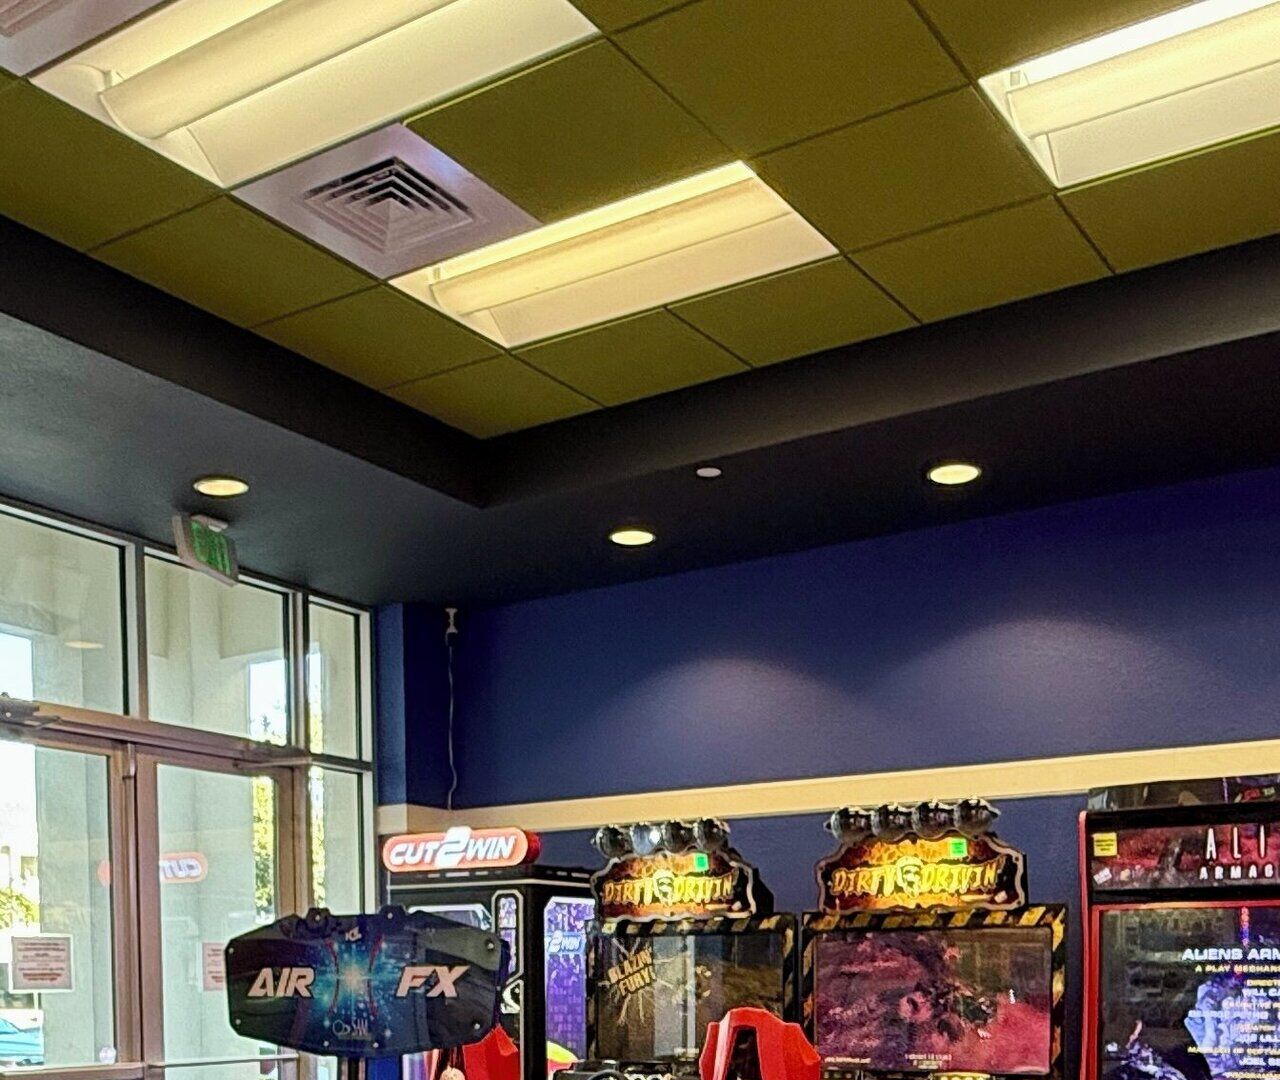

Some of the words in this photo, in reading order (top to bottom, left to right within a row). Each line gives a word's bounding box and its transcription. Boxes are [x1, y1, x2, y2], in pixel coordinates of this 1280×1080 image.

[604, 876, 655, 905] DIRTY
[831, 864, 899, 896] DIRTY
[1181, 948, 1243, 960] ALIENS
[1194, 964, 1202, 973] A
[1205, 964, 1231, 973] PLAY
[247, 966, 315, 998] AIR
[395, 965, 471, 998] FX
